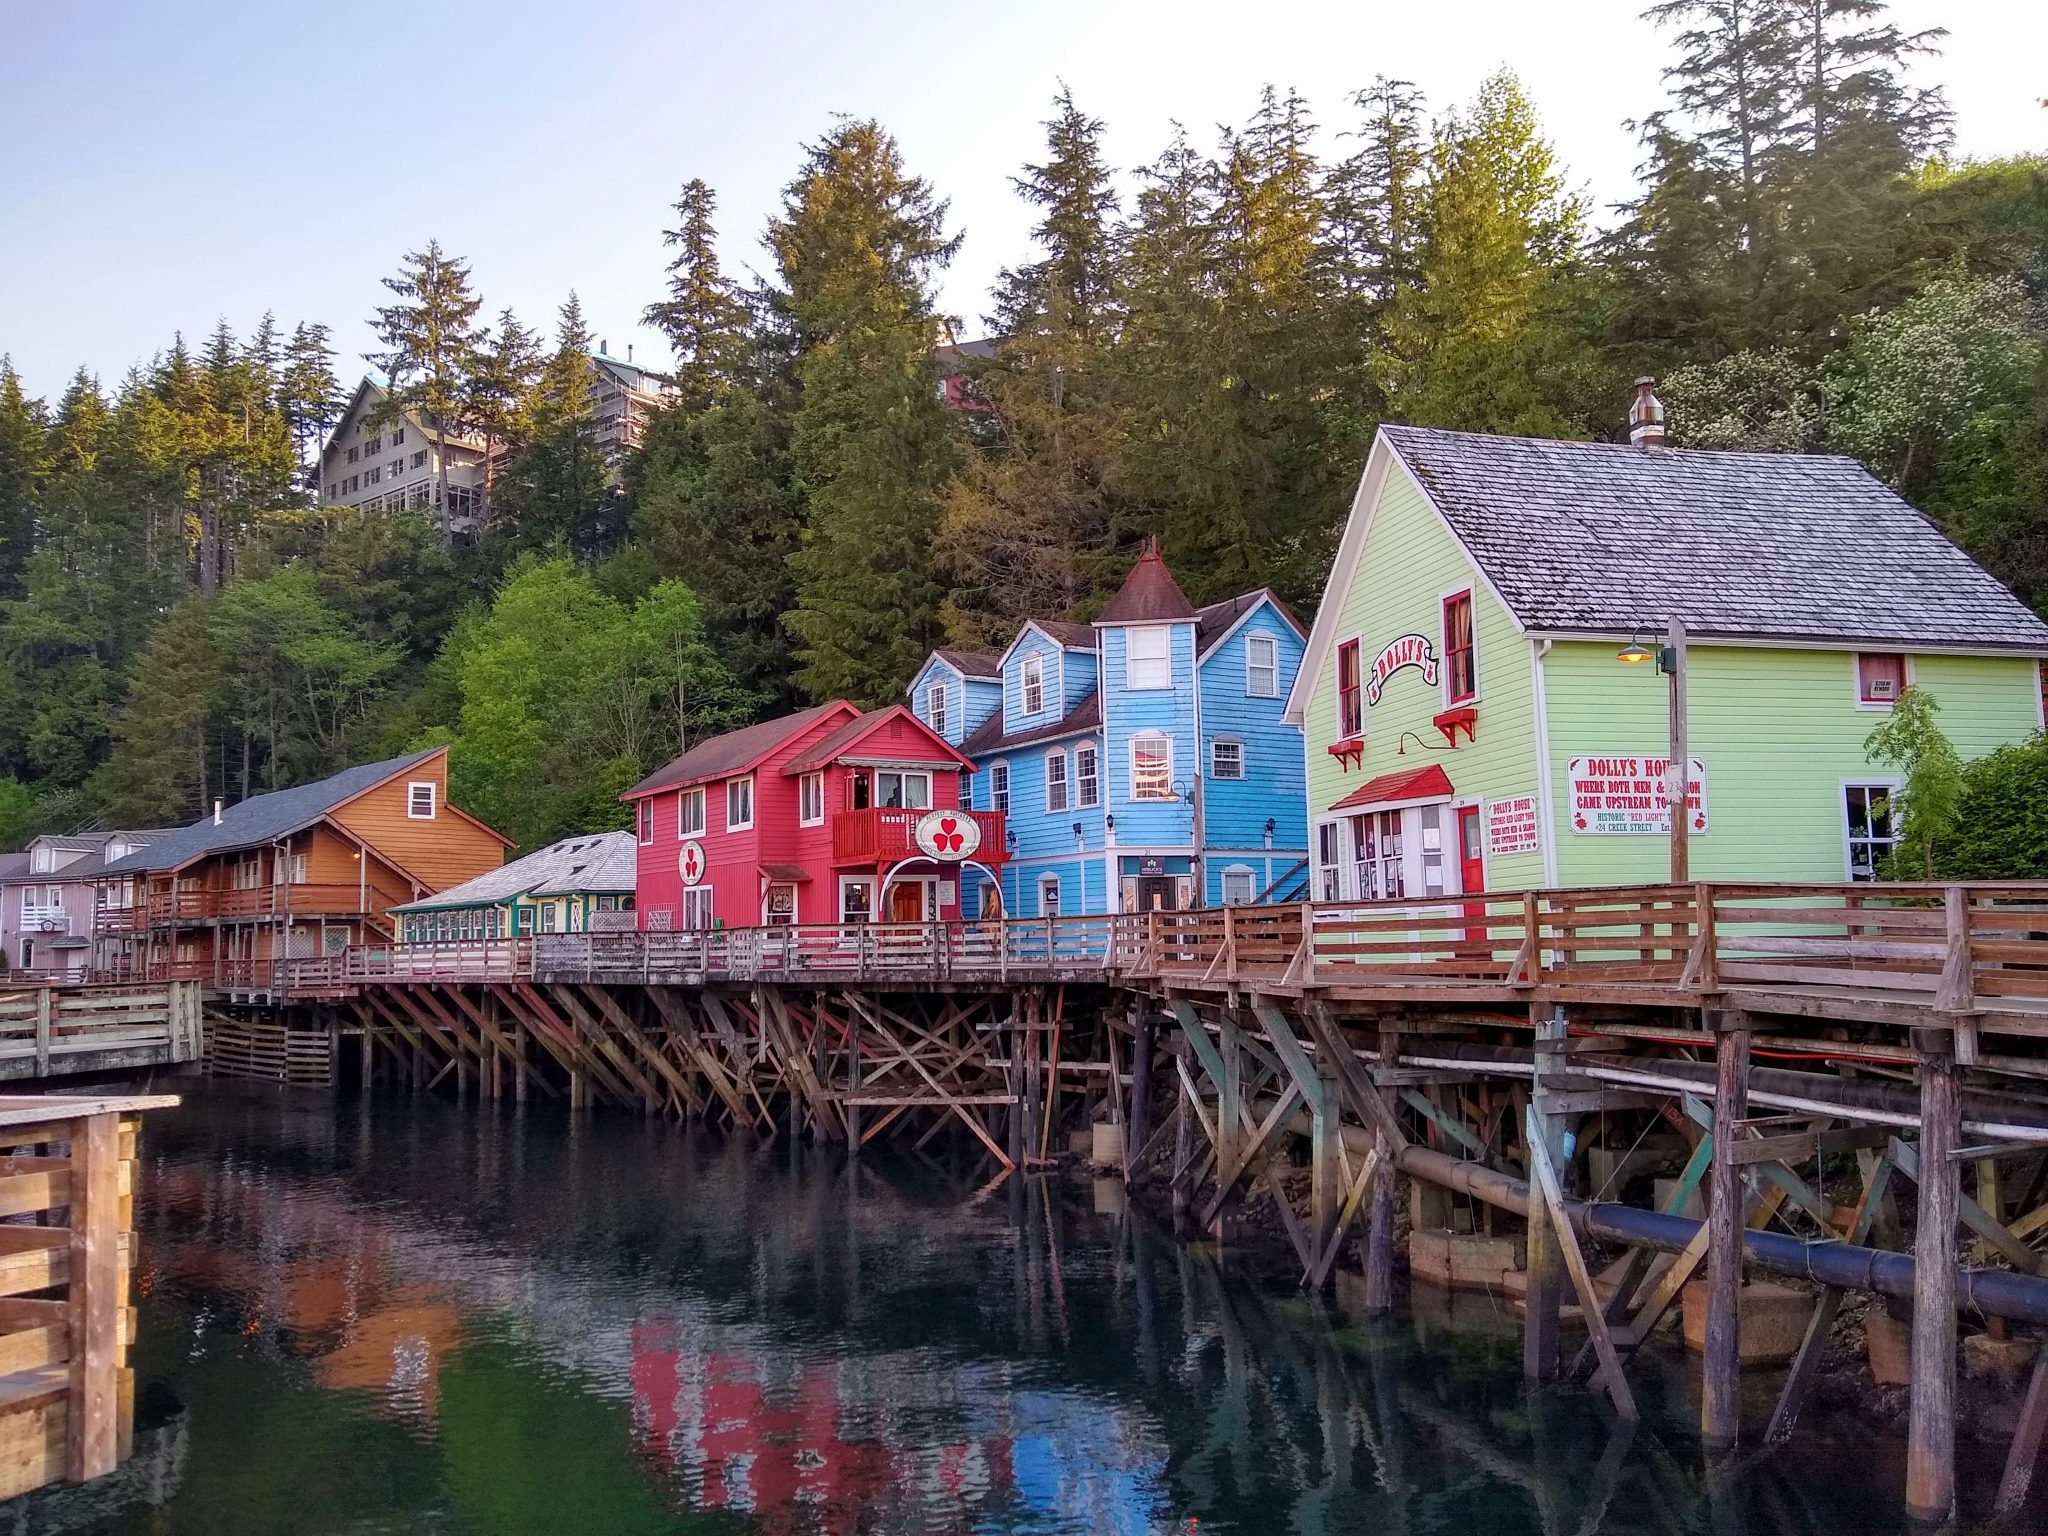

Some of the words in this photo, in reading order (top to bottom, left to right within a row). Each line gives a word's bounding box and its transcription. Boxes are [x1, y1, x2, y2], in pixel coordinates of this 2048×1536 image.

[1378, 637, 1424, 679] DOLLY'S
[1588, 758, 1637, 777] DOLLY'S
[1645, 760, 1671, 777] HOU
[1574, 781, 1605, 793] WHERE
[1608, 781, 1631, 793] BOTH
[1633, 781, 1652, 793] MEN
[1656, 781, 1665, 793] &
[1576, 796, 1602, 809] CAME
[1605, 796, 1651, 809] UPSTREAM
[1655, 796, 1667, 809] TO
[1597, 812, 1626, 822] HISTORIC
[1608, 823, 1628, 832] CREEK
[1630, 823, 1653, 832] STREET
